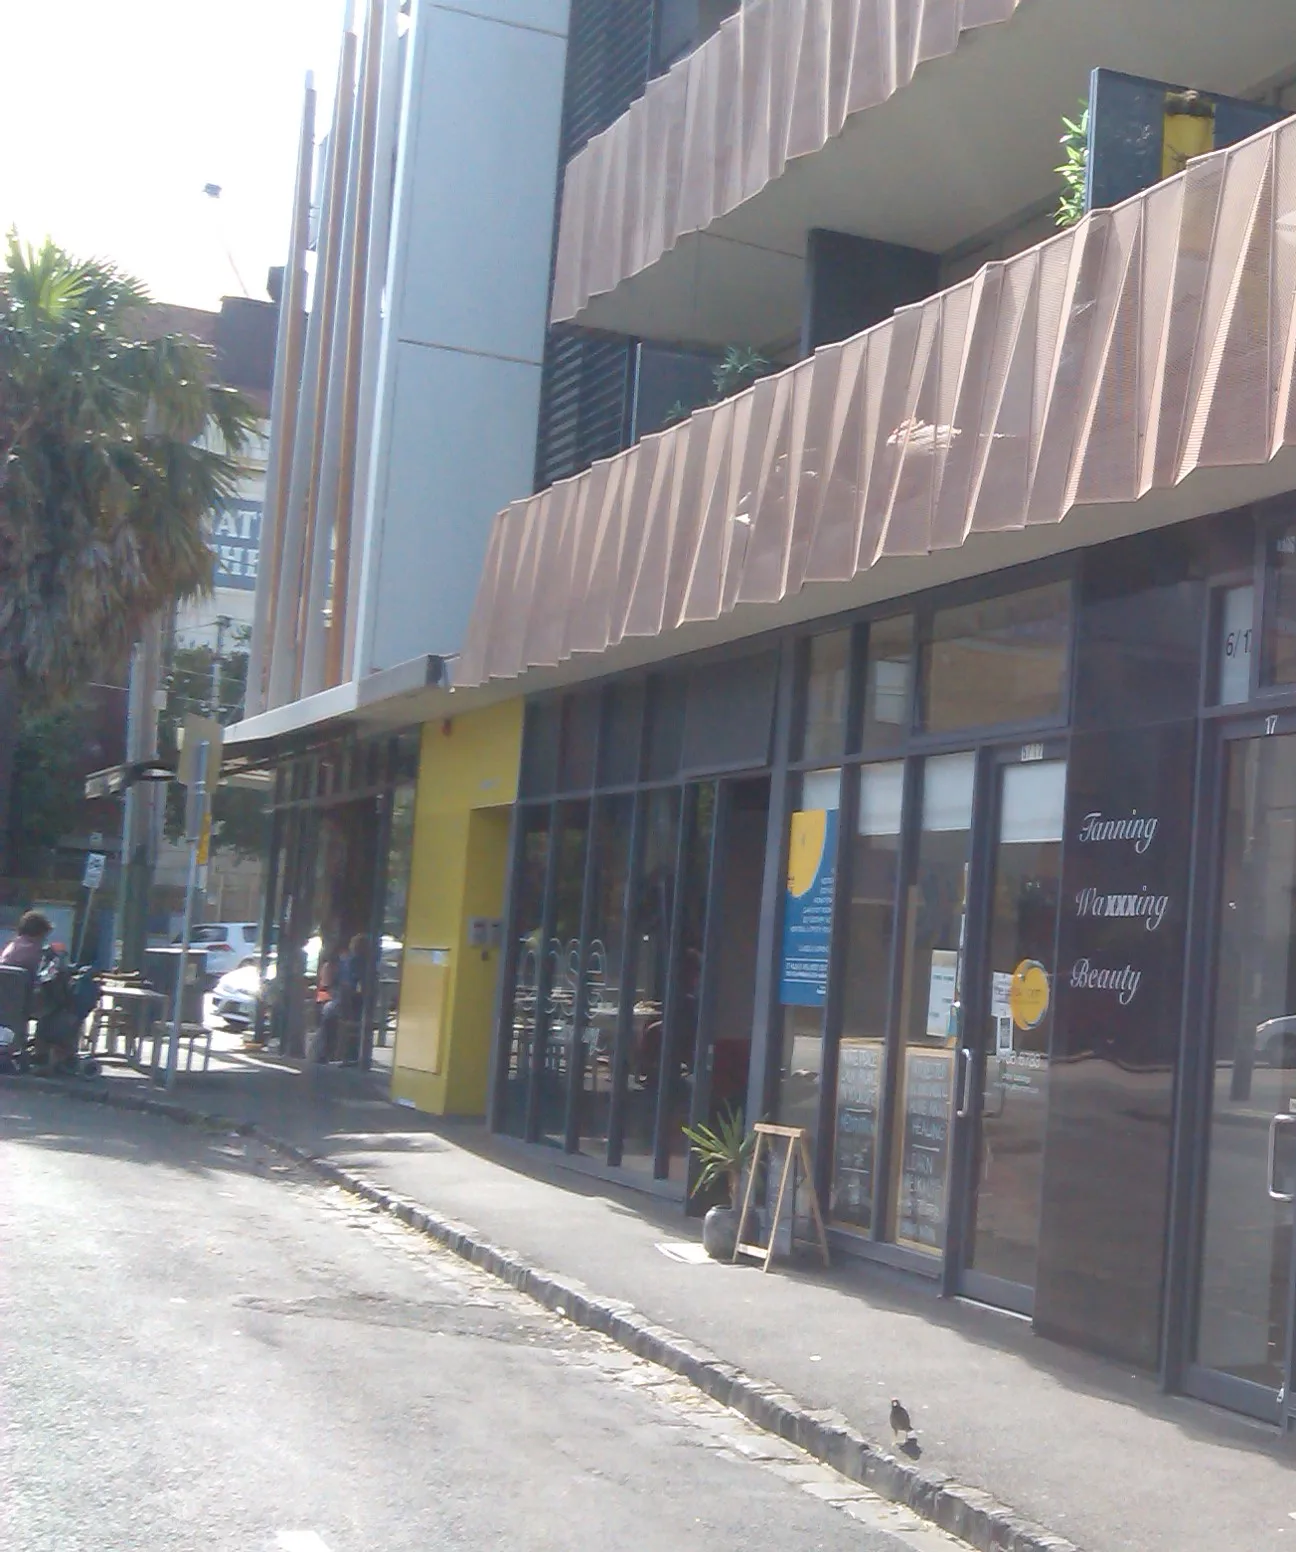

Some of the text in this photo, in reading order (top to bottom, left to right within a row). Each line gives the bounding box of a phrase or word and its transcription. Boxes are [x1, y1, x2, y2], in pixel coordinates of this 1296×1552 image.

[1264, 715, 1279, 735] 17
[1079, 809, 1158, 853] Tanning
[1075, 885, 1169, 931] Waxxxing
[1070, 958, 1142, 1005] Beauty
